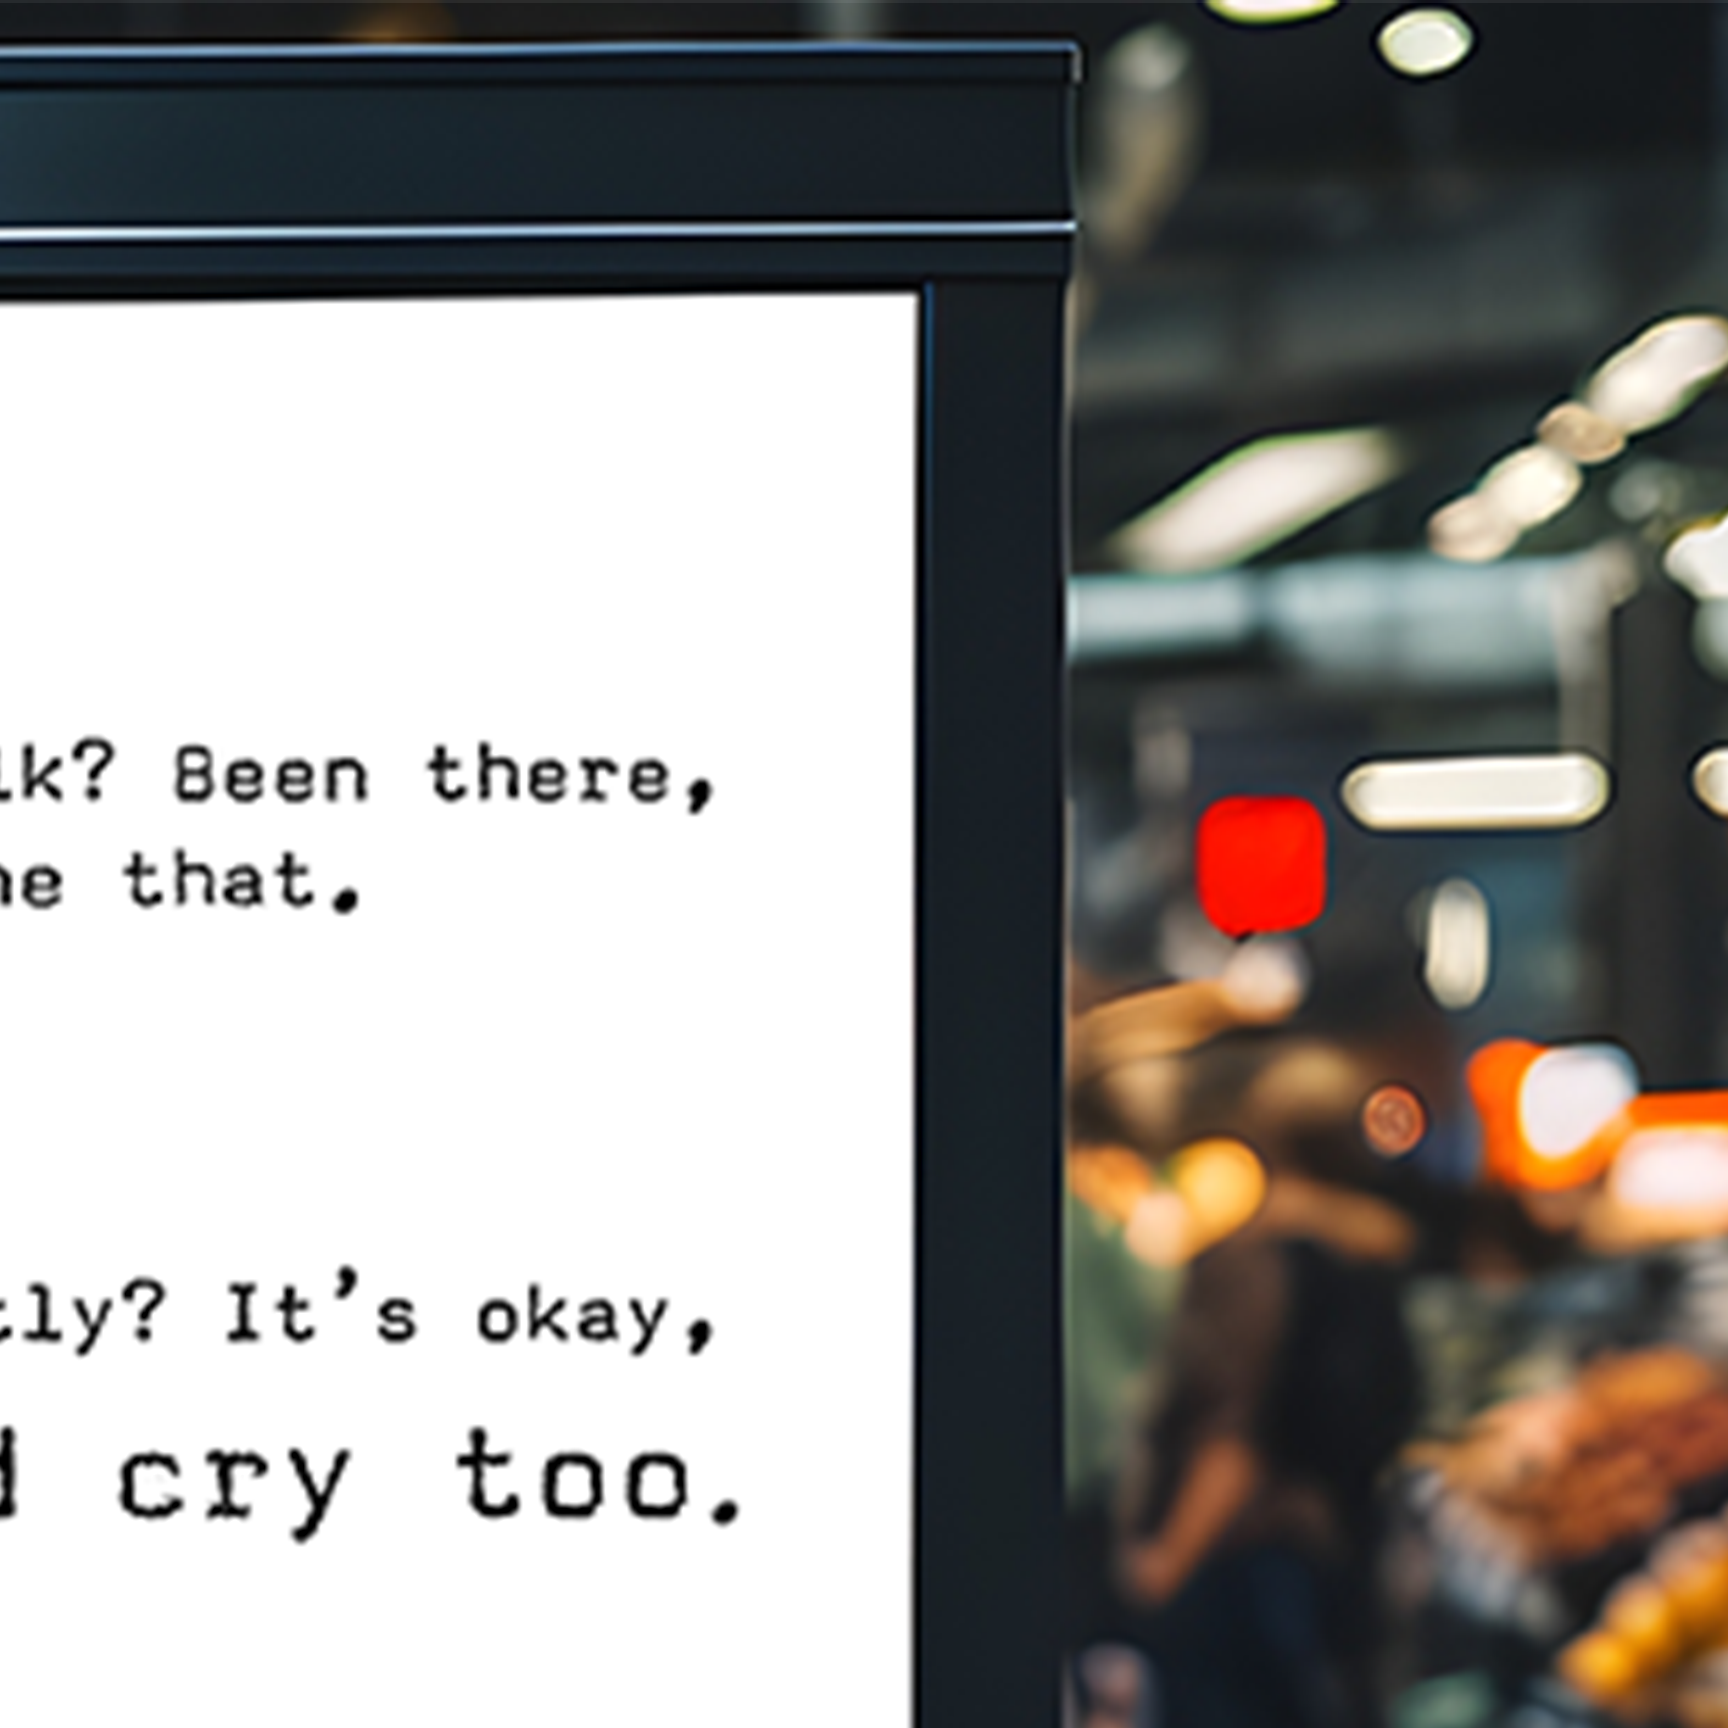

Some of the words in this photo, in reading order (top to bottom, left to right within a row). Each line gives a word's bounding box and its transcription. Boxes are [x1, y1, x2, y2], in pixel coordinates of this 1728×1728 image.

[174, 743, 369, 805] Been
[426, 740, 713, 816] there,
[122, 847, 360, 916] that.
[226, 1264, 418, 1345] It’s
[477, 1283, 713, 1358] okay,
[118, 1447, 352, 1545] cry
[455, 1425, 740, 1527] too.
